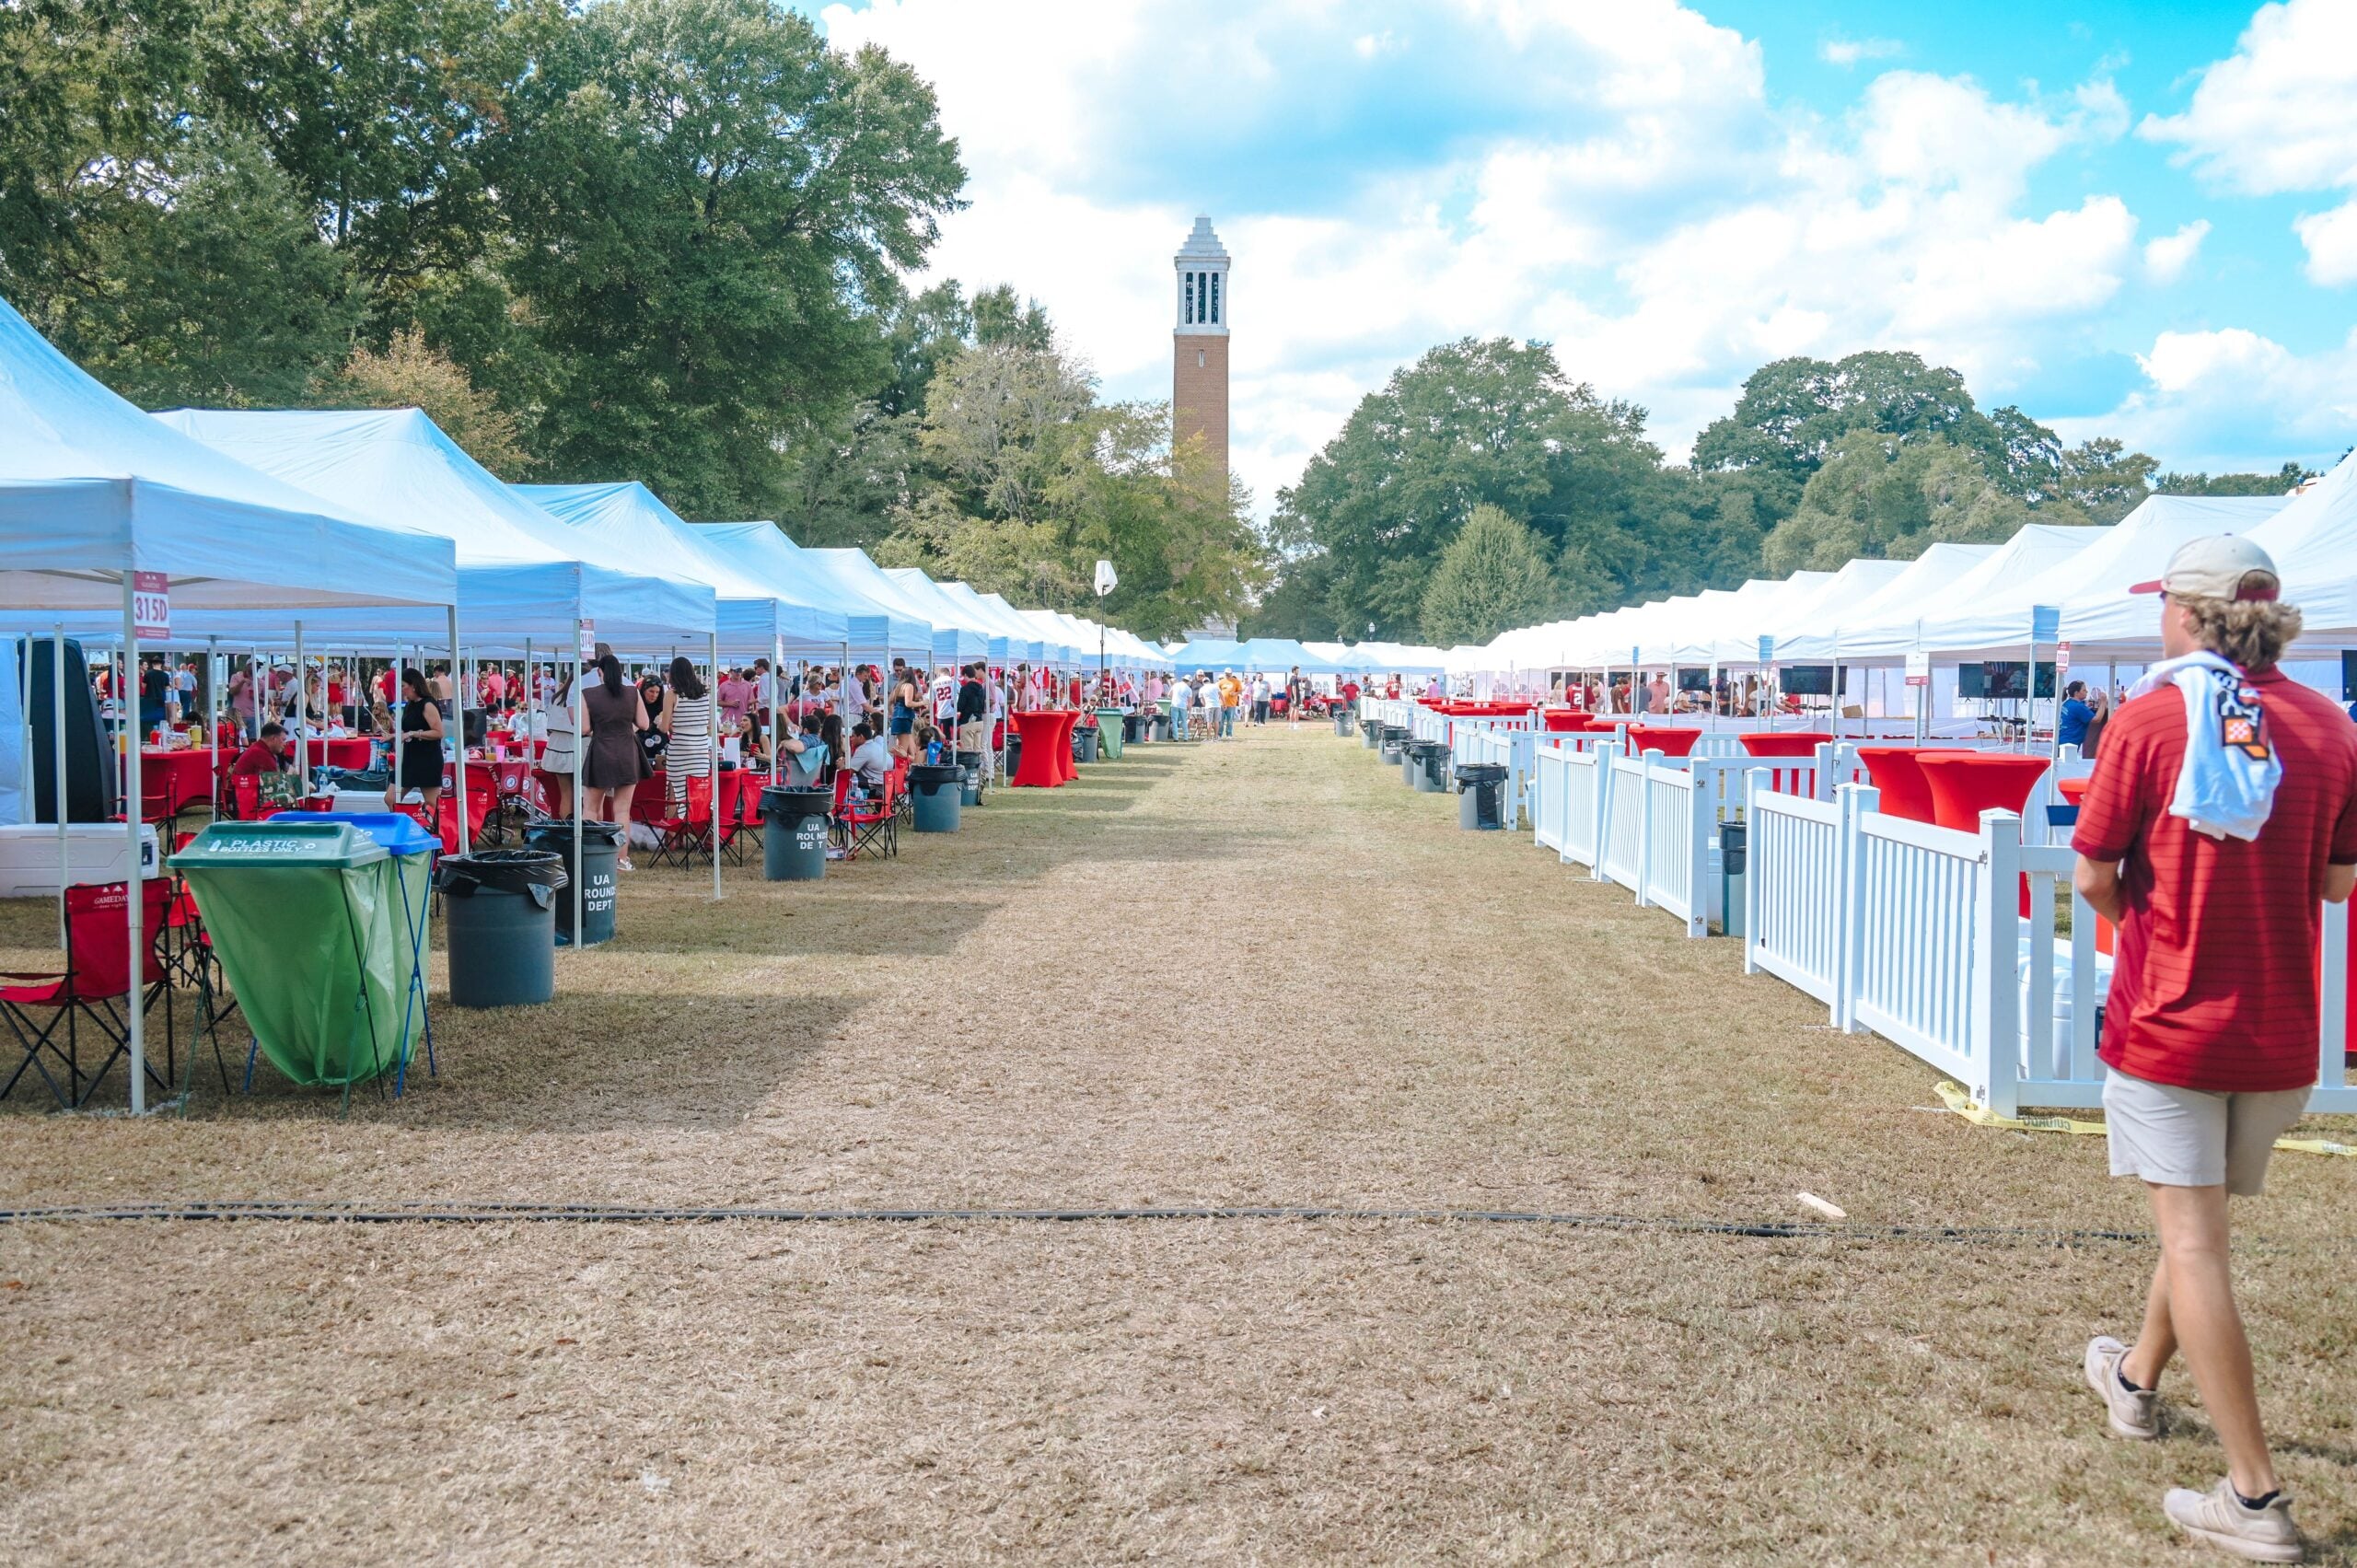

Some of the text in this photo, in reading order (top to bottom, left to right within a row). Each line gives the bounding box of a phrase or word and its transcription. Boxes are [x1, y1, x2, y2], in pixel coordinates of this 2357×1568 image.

[135, 597, 167, 621] 315D
[936, 686, 952, 701] 22
[807, 823, 819, 831] UA
[799, 841, 823, 850] DET
[593, 874, 610, 886] UA
[587, 899, 612, 912] DEPT
